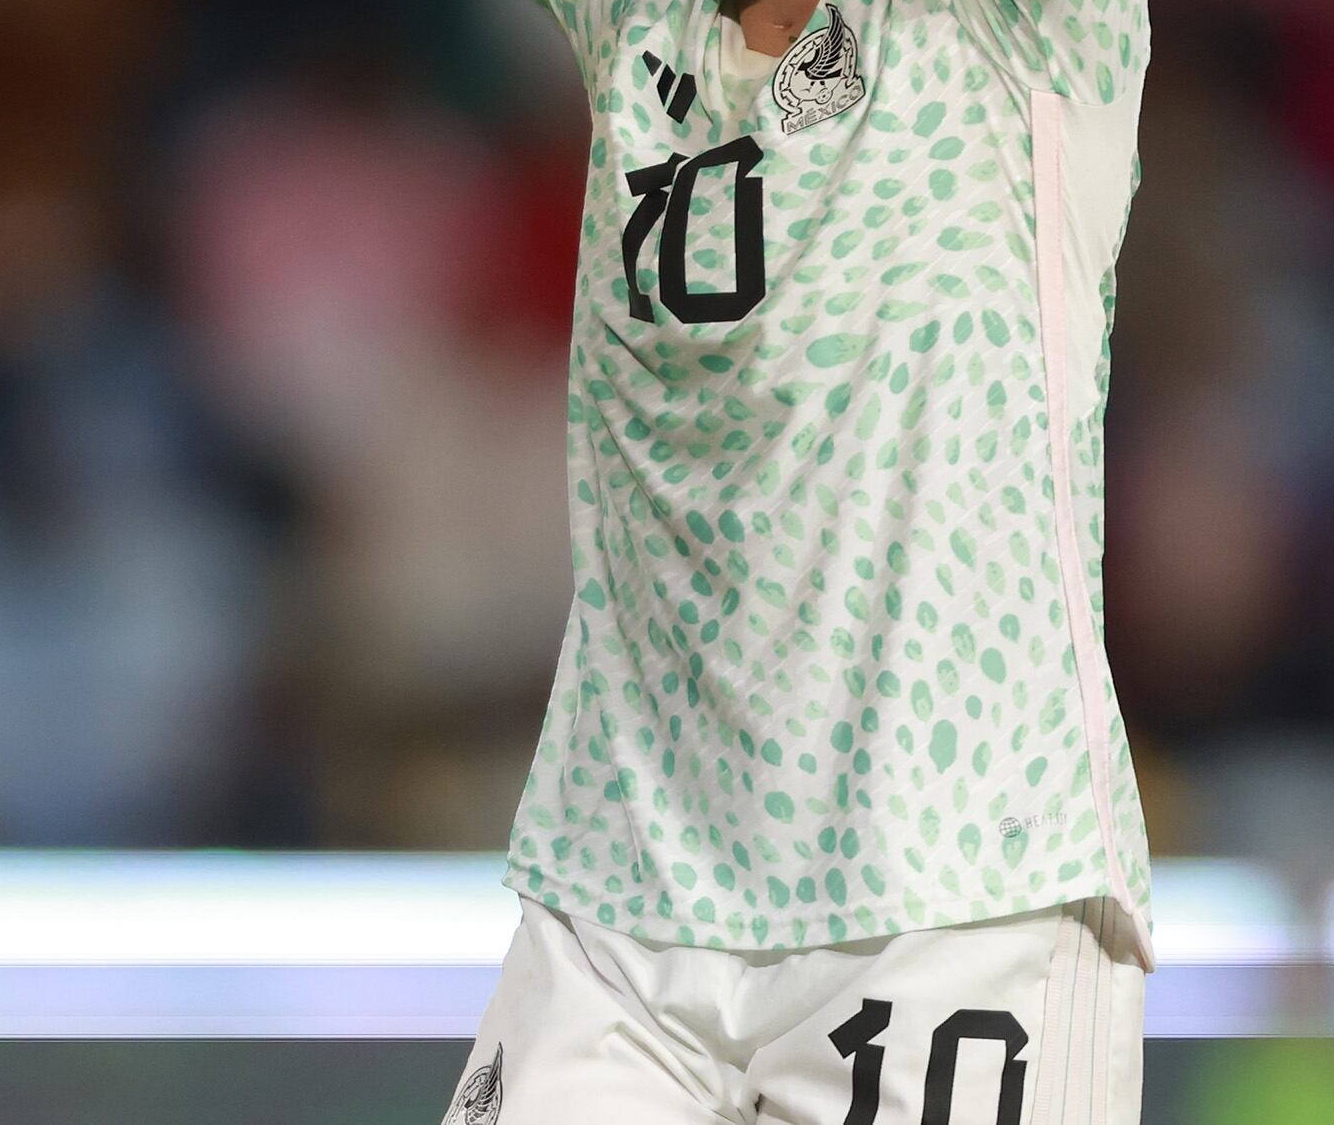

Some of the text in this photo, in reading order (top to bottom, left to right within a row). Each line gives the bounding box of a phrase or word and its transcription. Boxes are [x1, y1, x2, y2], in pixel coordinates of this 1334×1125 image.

[786, 84, 862, 133] MEXICO
[622, 135, 766, 324] 10
[828, 998, 1029, 1125] 10
